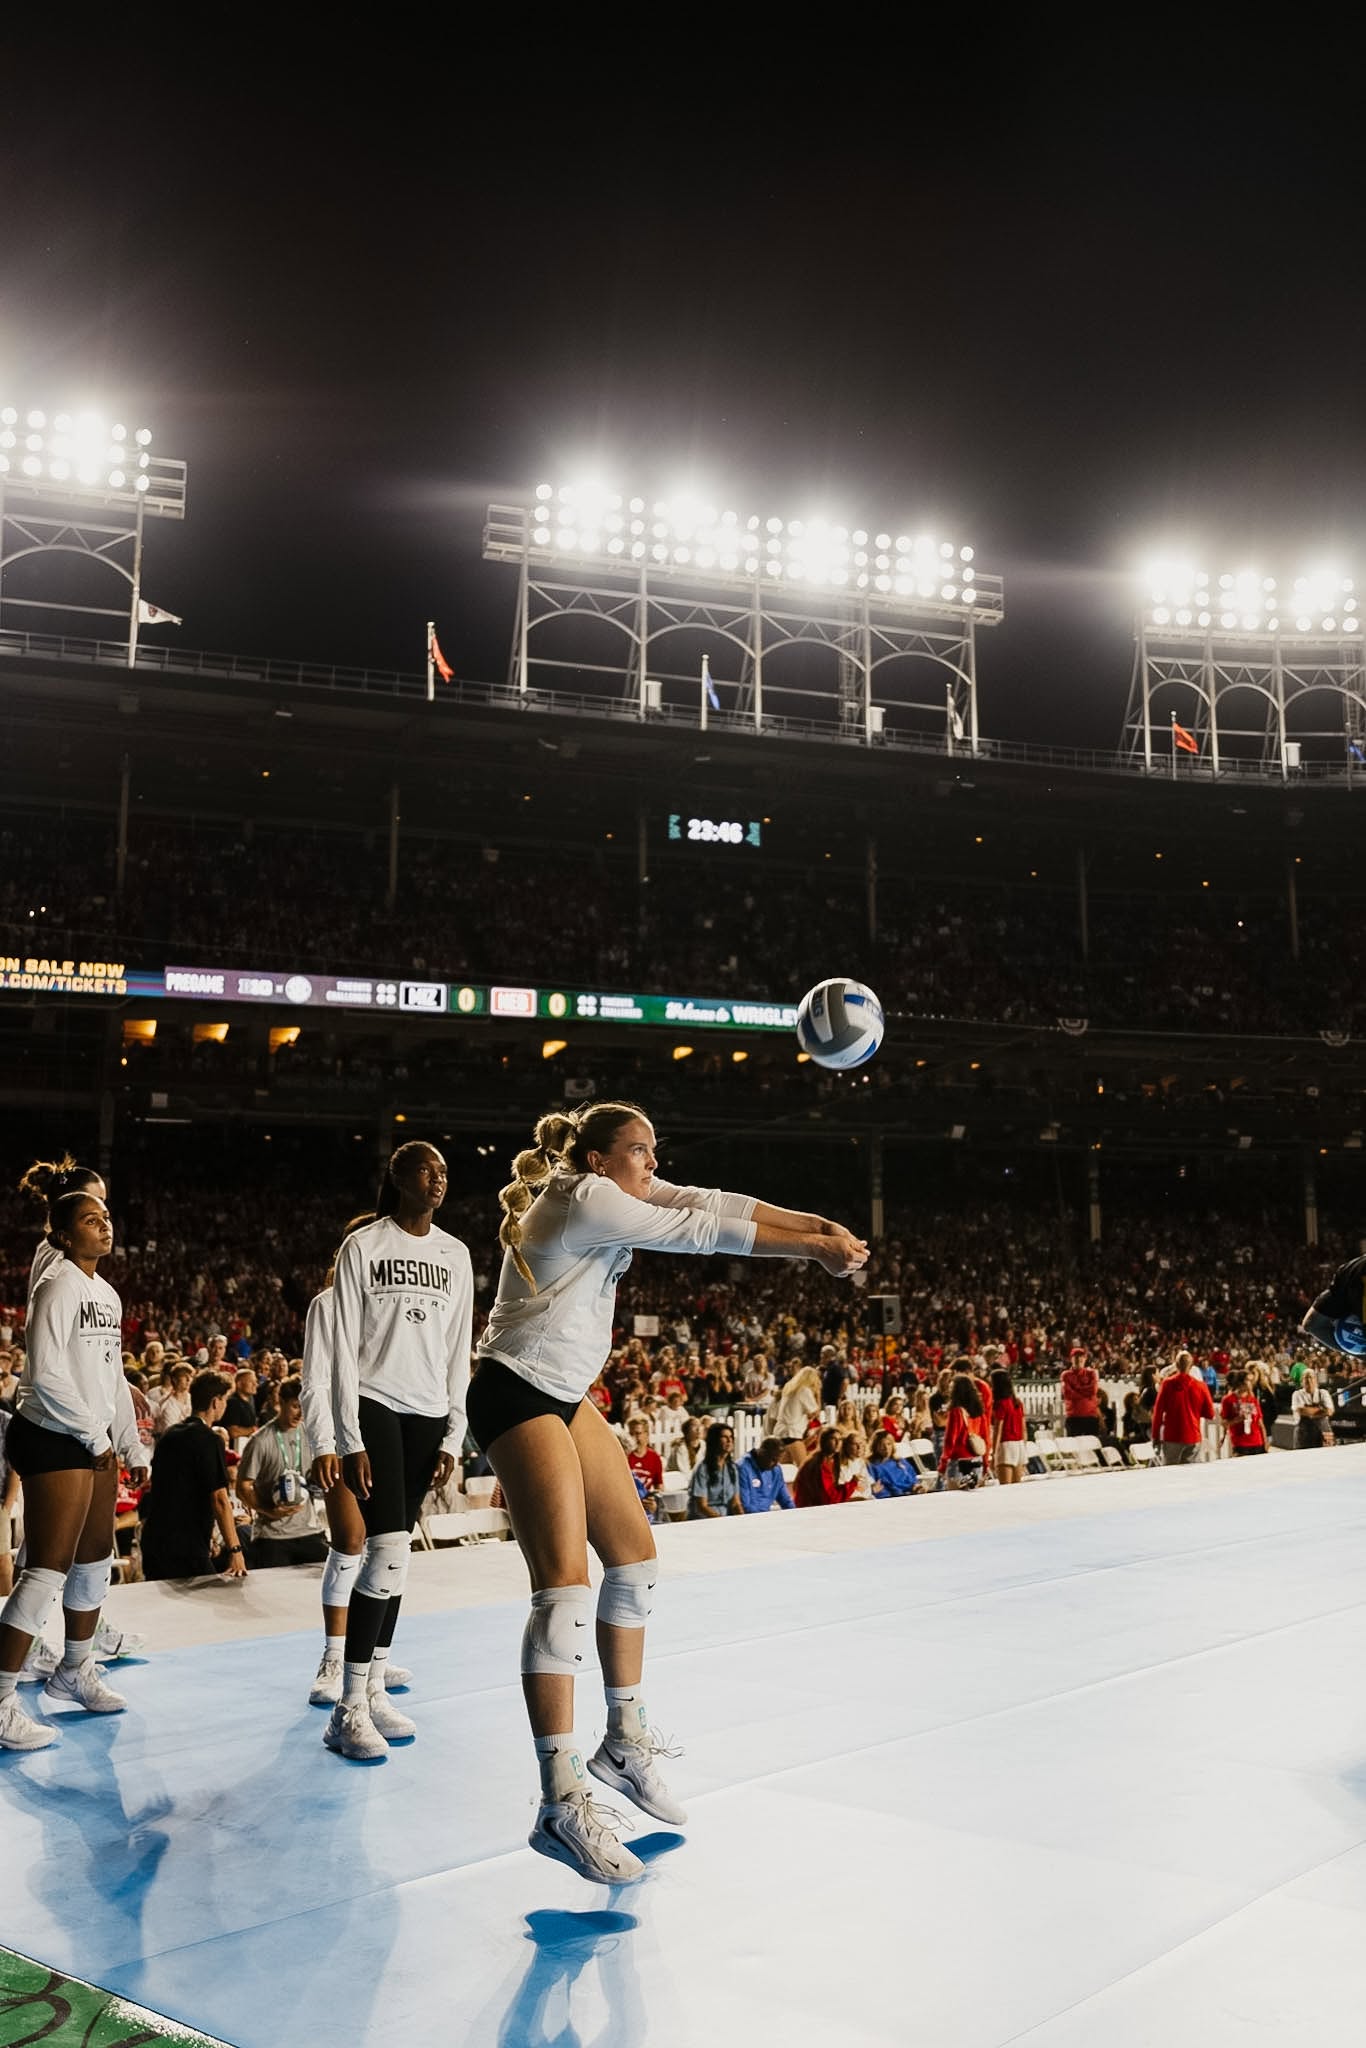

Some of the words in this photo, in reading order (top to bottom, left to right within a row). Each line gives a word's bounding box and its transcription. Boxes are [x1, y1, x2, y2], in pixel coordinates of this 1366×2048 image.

[25, 959, 74, 975] SALE
[80, 962, 125, 978] NOW
[458, 987, 476, 1012] 0
[549, 993, 566, 1017] 0
[370, 1259, 449, 1295] MISSOURI
